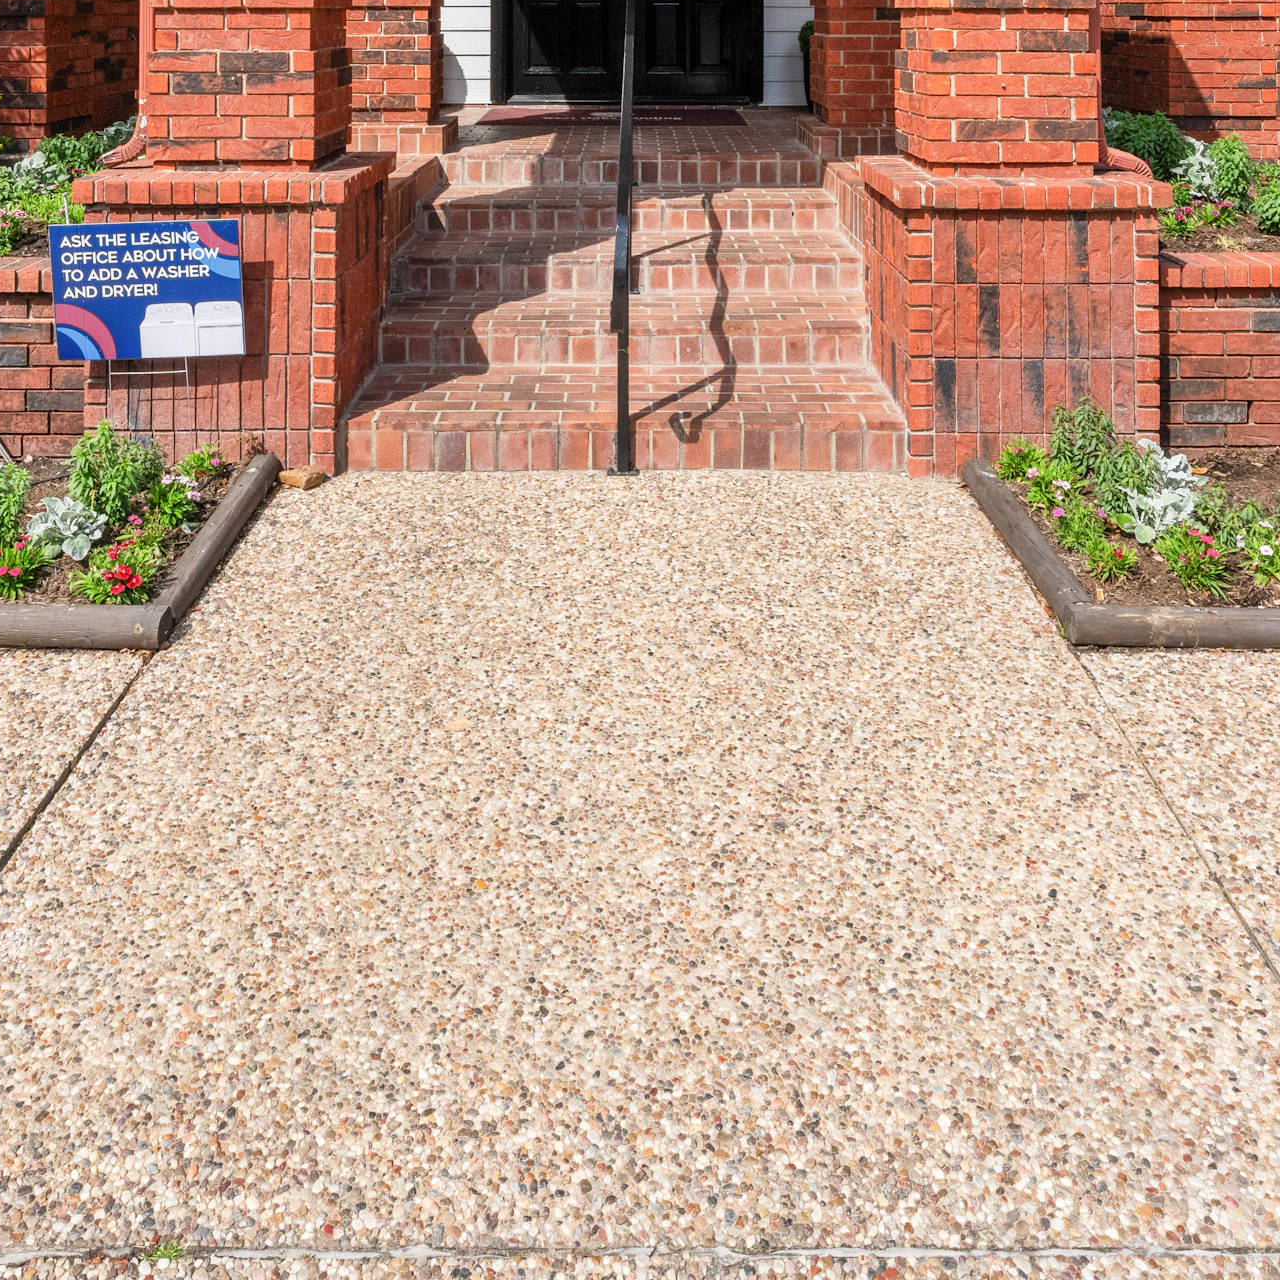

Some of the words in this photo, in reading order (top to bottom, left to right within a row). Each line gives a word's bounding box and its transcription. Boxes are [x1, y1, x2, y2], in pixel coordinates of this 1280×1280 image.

[60, 234, 93, 248] ASK
[96, 233, 127, 247] THE
[131, 231, 200, 246] LEASING
[60, 251, 119, 265] OFFICE
[122, 249, 177, 264] ABOUT
[180, 247, 220, 261] HOW
[62, 269, 84, 282] TO
[87, 267, 122, 281] ADD
[126, 266, 139, 280] A
[141, 264, 210, 279] WASHER
[63, 286, 98, 299] AND
[102, 283, 159, 298] DRYER!
